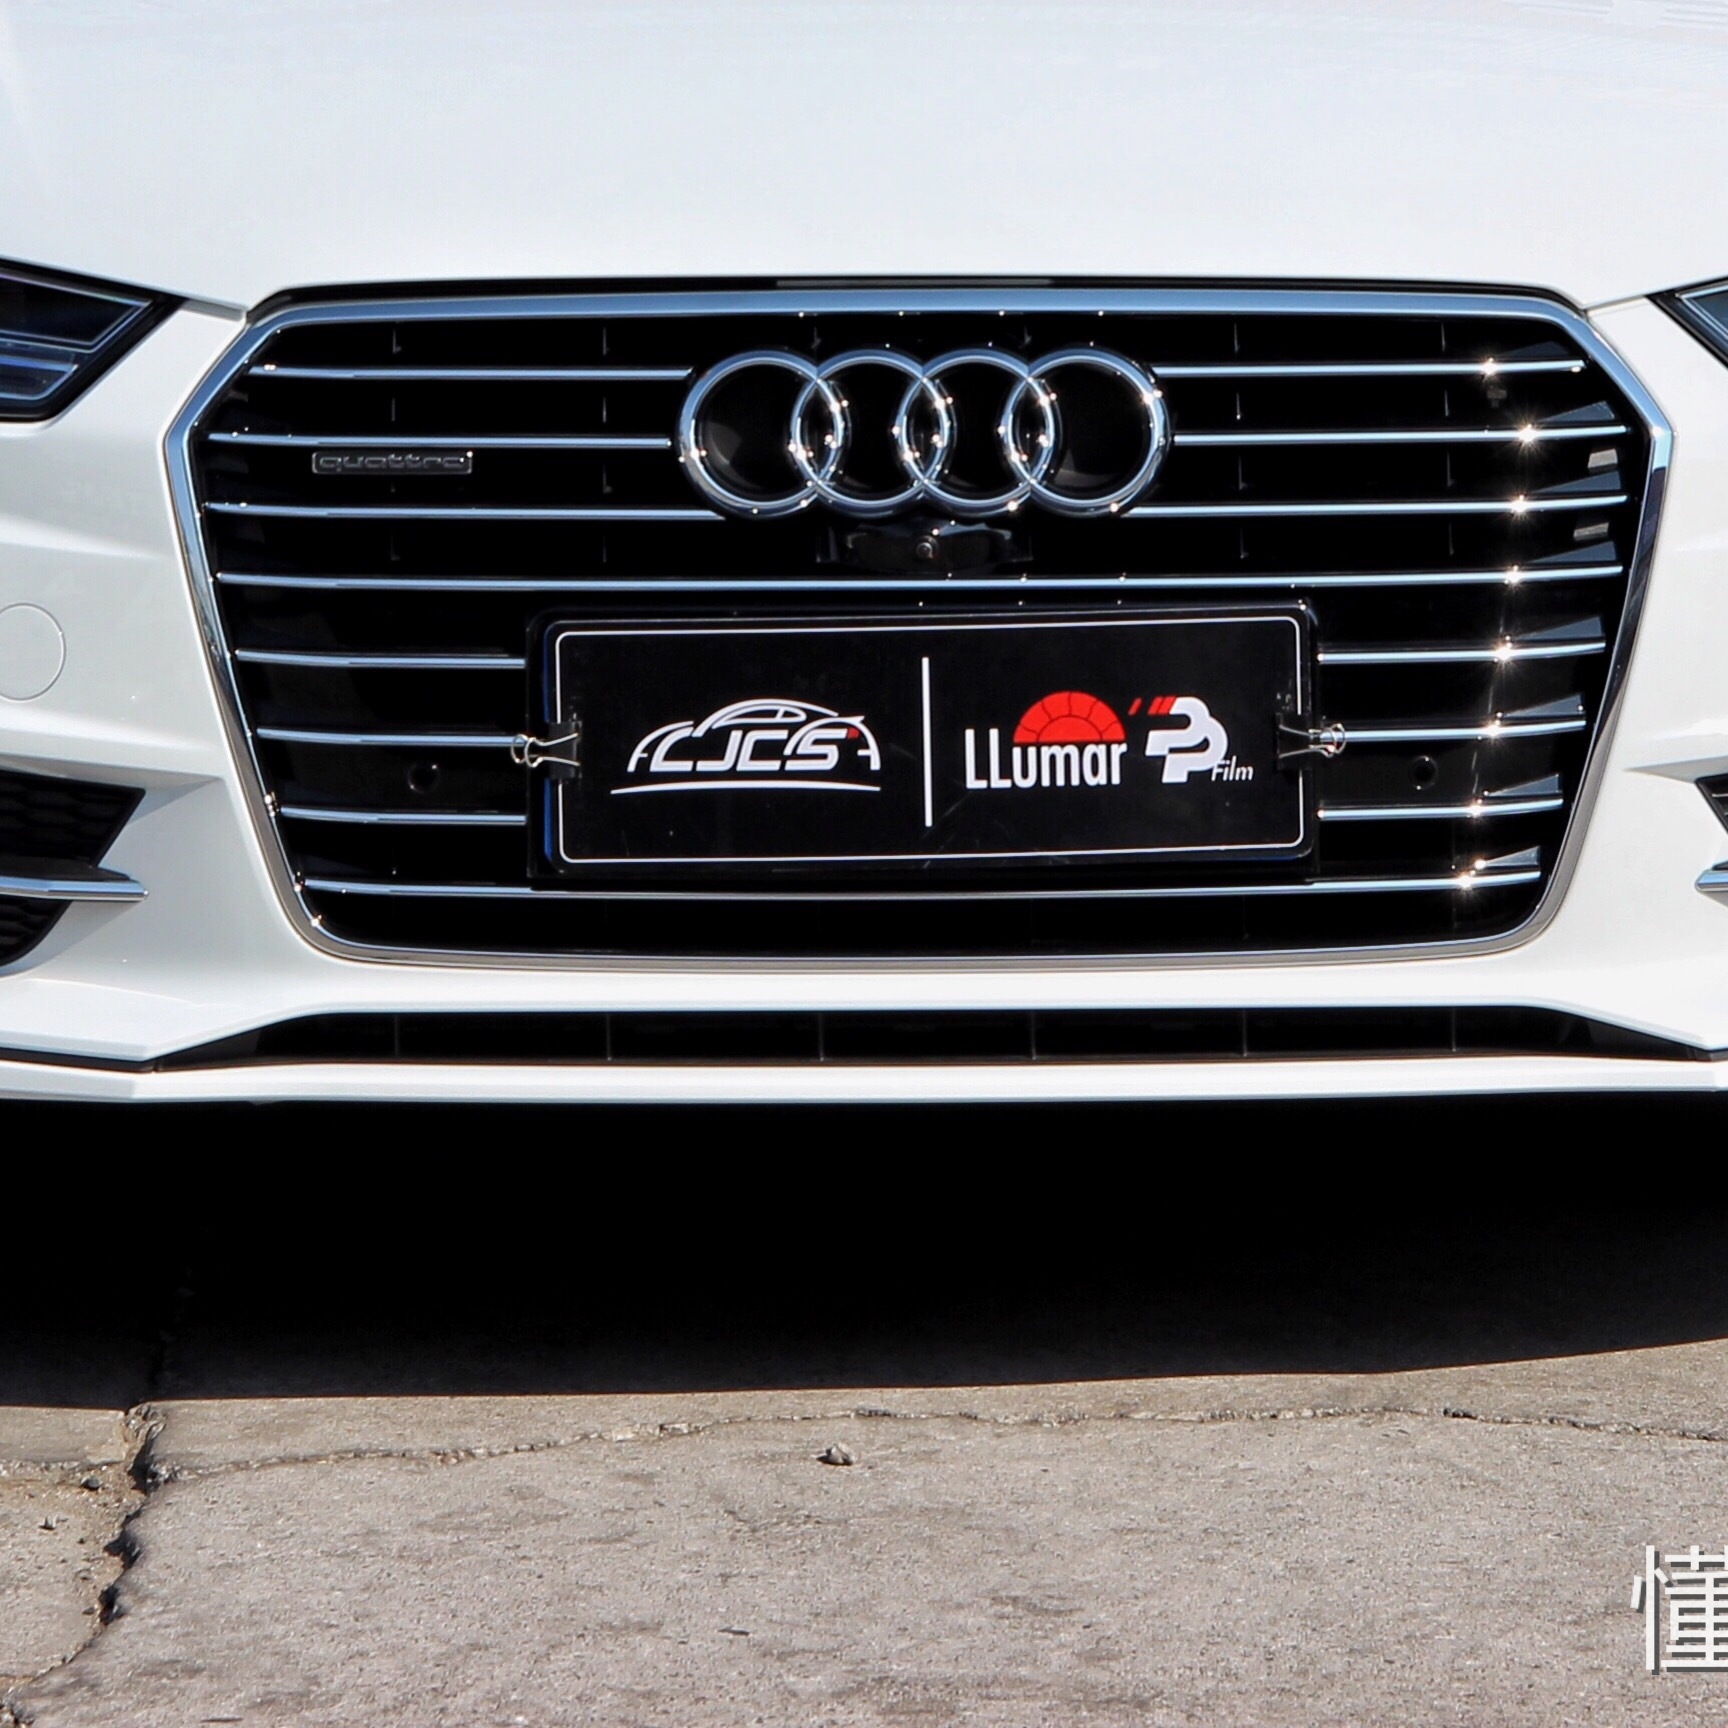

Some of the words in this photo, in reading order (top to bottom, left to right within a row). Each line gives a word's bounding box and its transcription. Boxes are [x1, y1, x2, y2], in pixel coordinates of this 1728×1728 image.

[318, 453, 465, 472] quattro
[964, 727, 1128, 790] LLumar
[1209, 756, 1255, 784] Film
